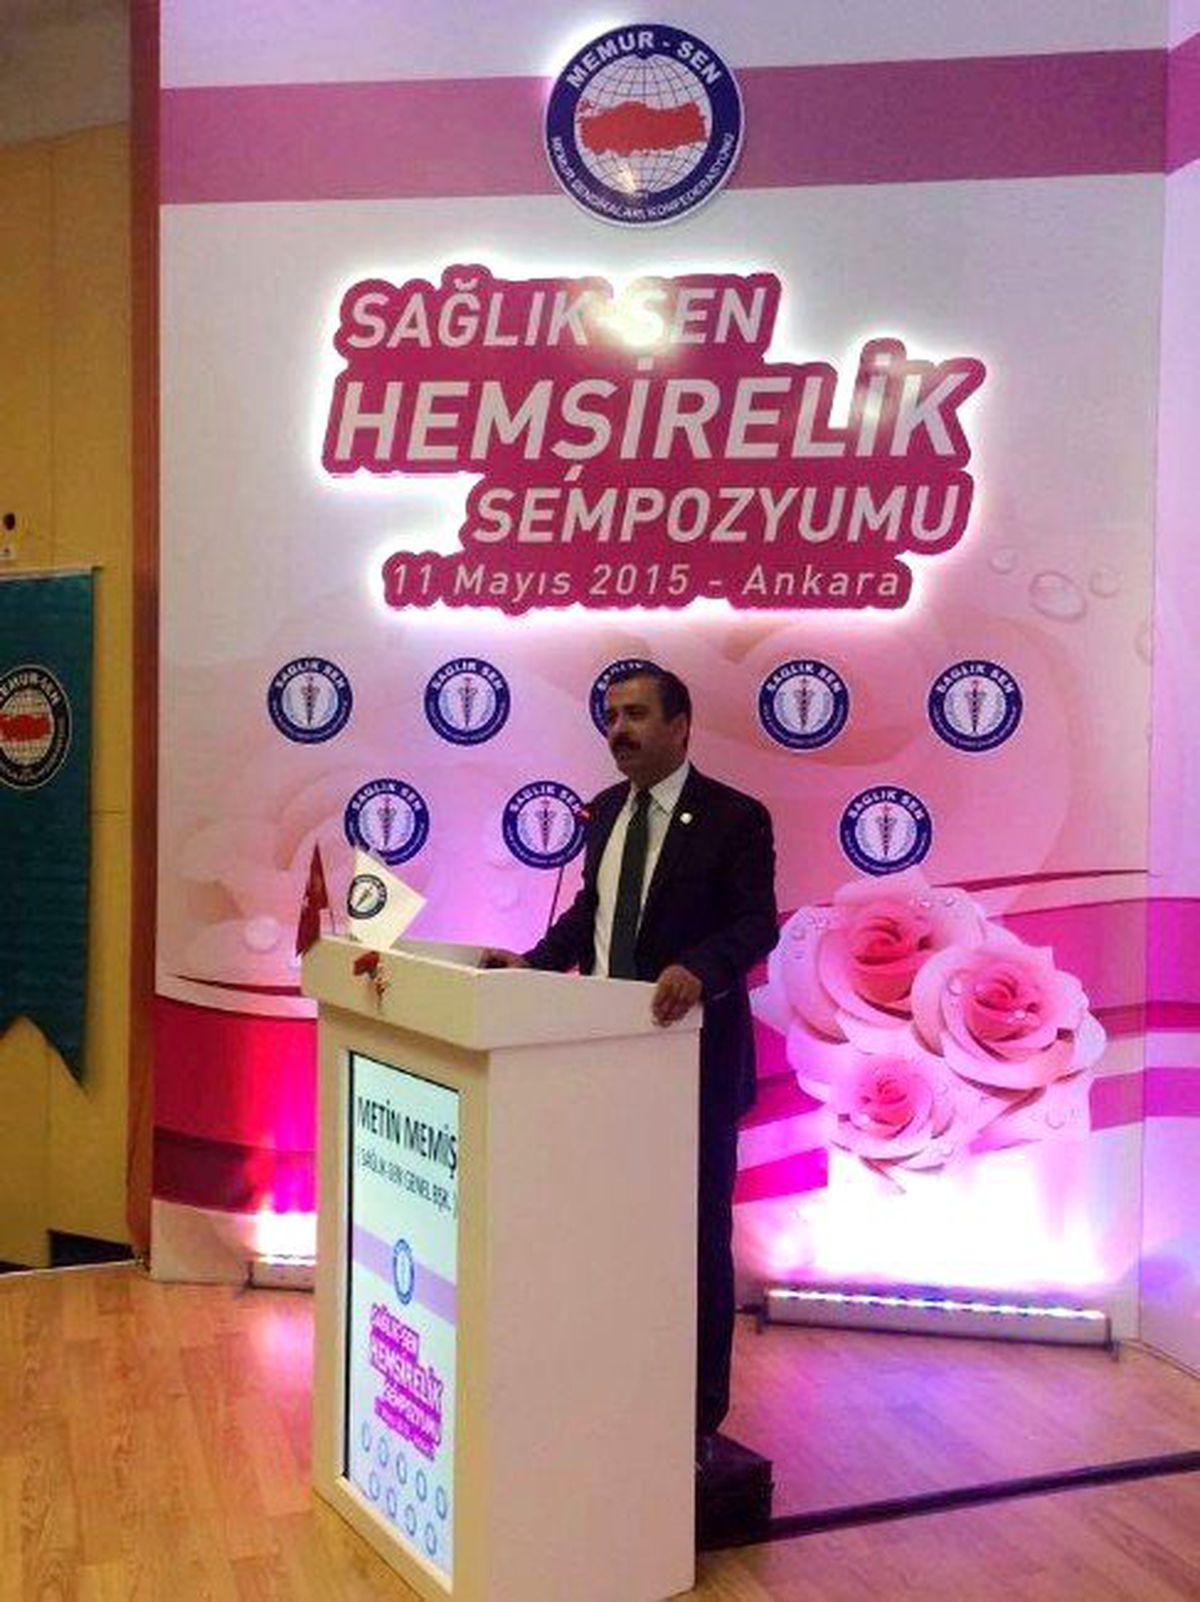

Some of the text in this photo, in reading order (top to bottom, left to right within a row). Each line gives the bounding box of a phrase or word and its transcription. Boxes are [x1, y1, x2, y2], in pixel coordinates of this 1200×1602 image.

[567, 31, 654, 88] MEMUR
[677, 41, 722, 85] SEN
[346, 277, 588, 347] SAĞLIK
[334, 355, 971, 481] HEMŞİRELİK
[473, 485, 959, 544] SEMPOZYUMU
[393, 564, 432, 595] 11
[454, 564, 571, 602] Mayıs
[589, 564, 690, 595] 2015
[742, 564, 899, 596] Ankara
[357, 1097, 457, 1179] METİN MEMİŞ
